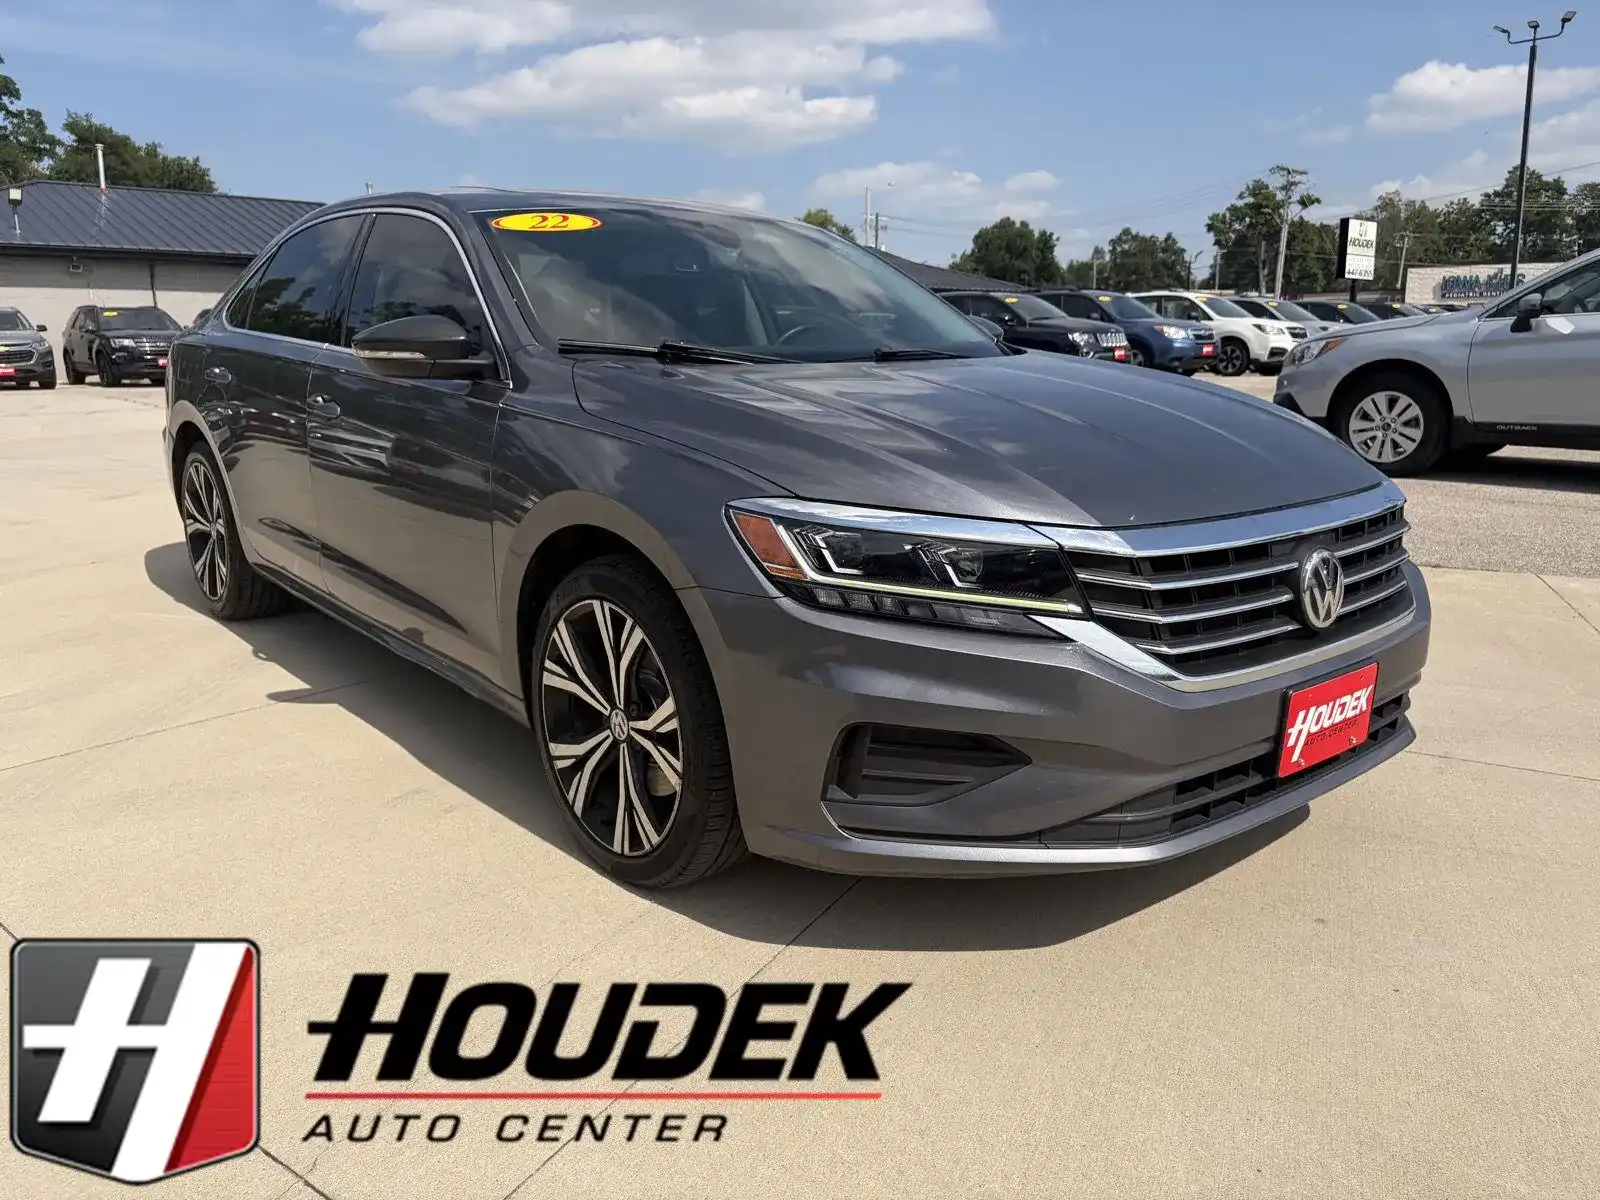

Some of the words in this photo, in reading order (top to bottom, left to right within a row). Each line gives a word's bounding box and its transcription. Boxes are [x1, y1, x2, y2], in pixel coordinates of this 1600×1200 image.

[529, 214, 569, 229] 22
[1440, 274, 1480, 292] IOWA
[1287, 683, 1374, 763] HOUDEK
[1304, 733, 1326, 746] AUTO
[1328, 721, 1357, 738] CENTER
